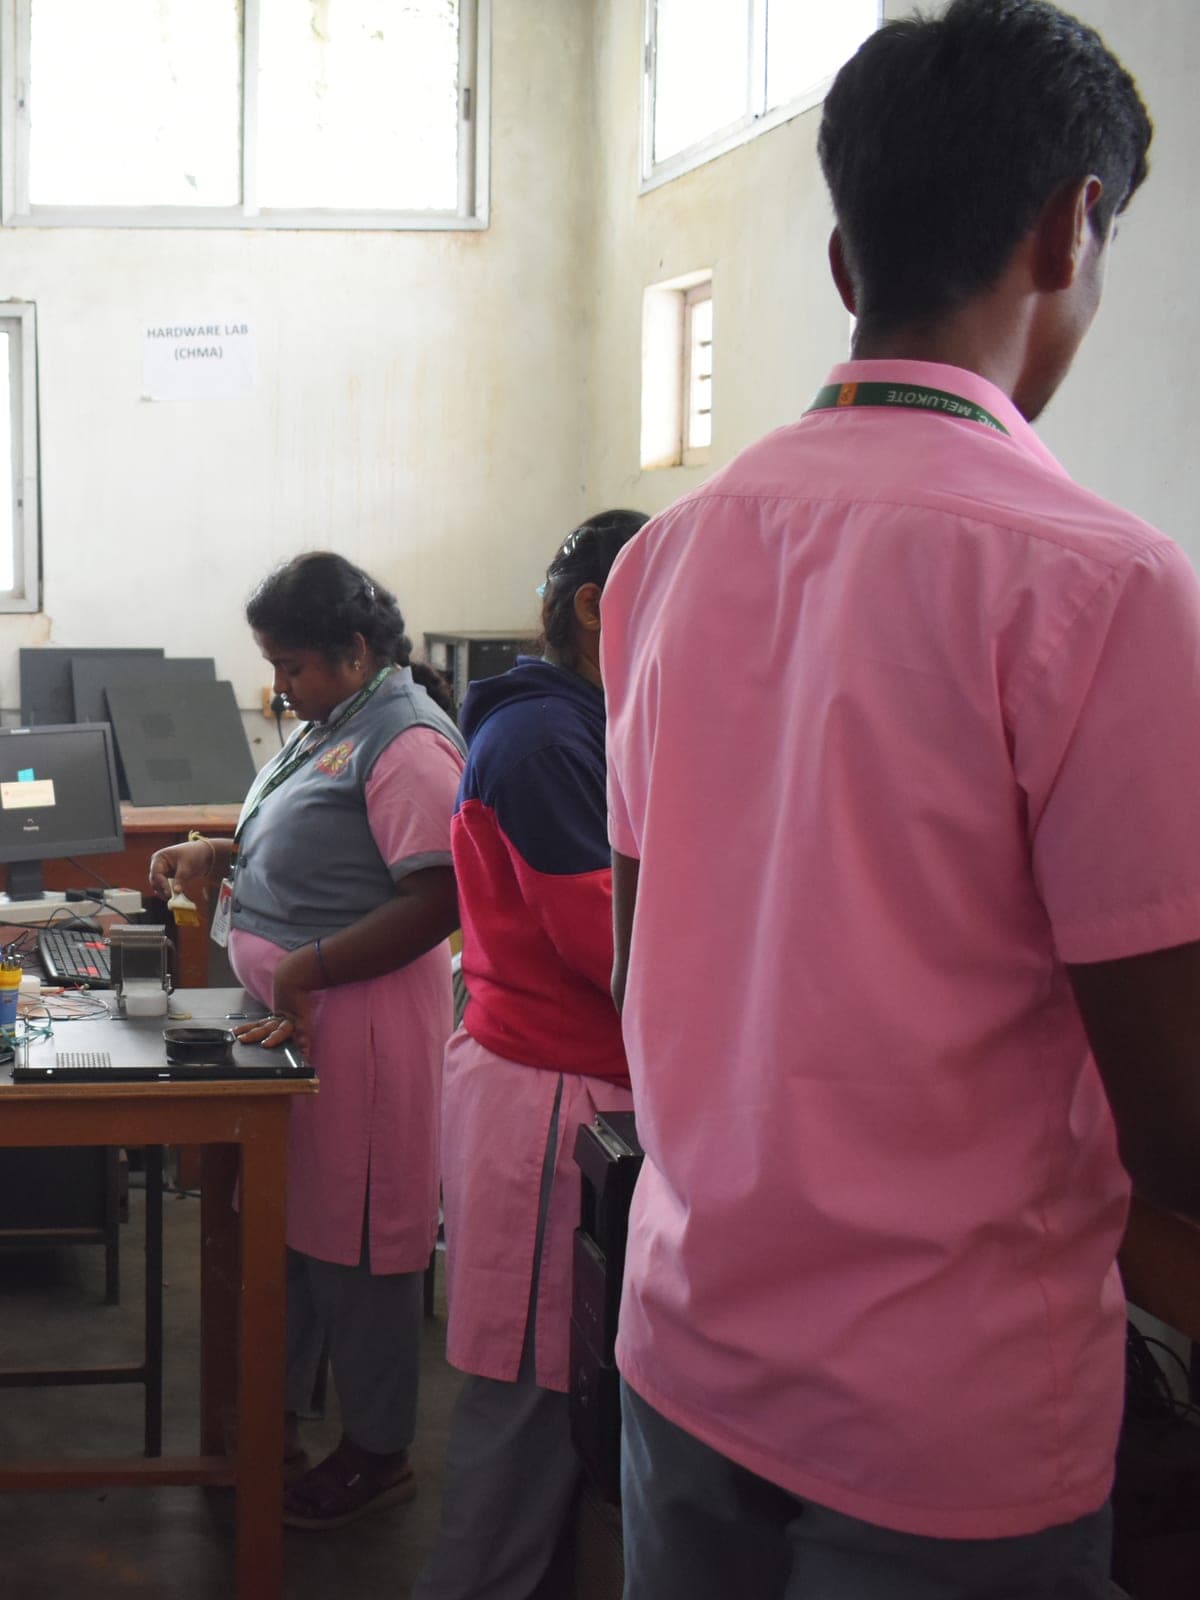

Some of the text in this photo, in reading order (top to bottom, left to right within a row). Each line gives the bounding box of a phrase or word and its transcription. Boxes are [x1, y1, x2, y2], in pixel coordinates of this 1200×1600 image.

[147, 323, 249, 339] HARDWARE LAB
[174, 345, 224, 361] (CHMA)
[886, 389, 973, 417] MELUKOTE
